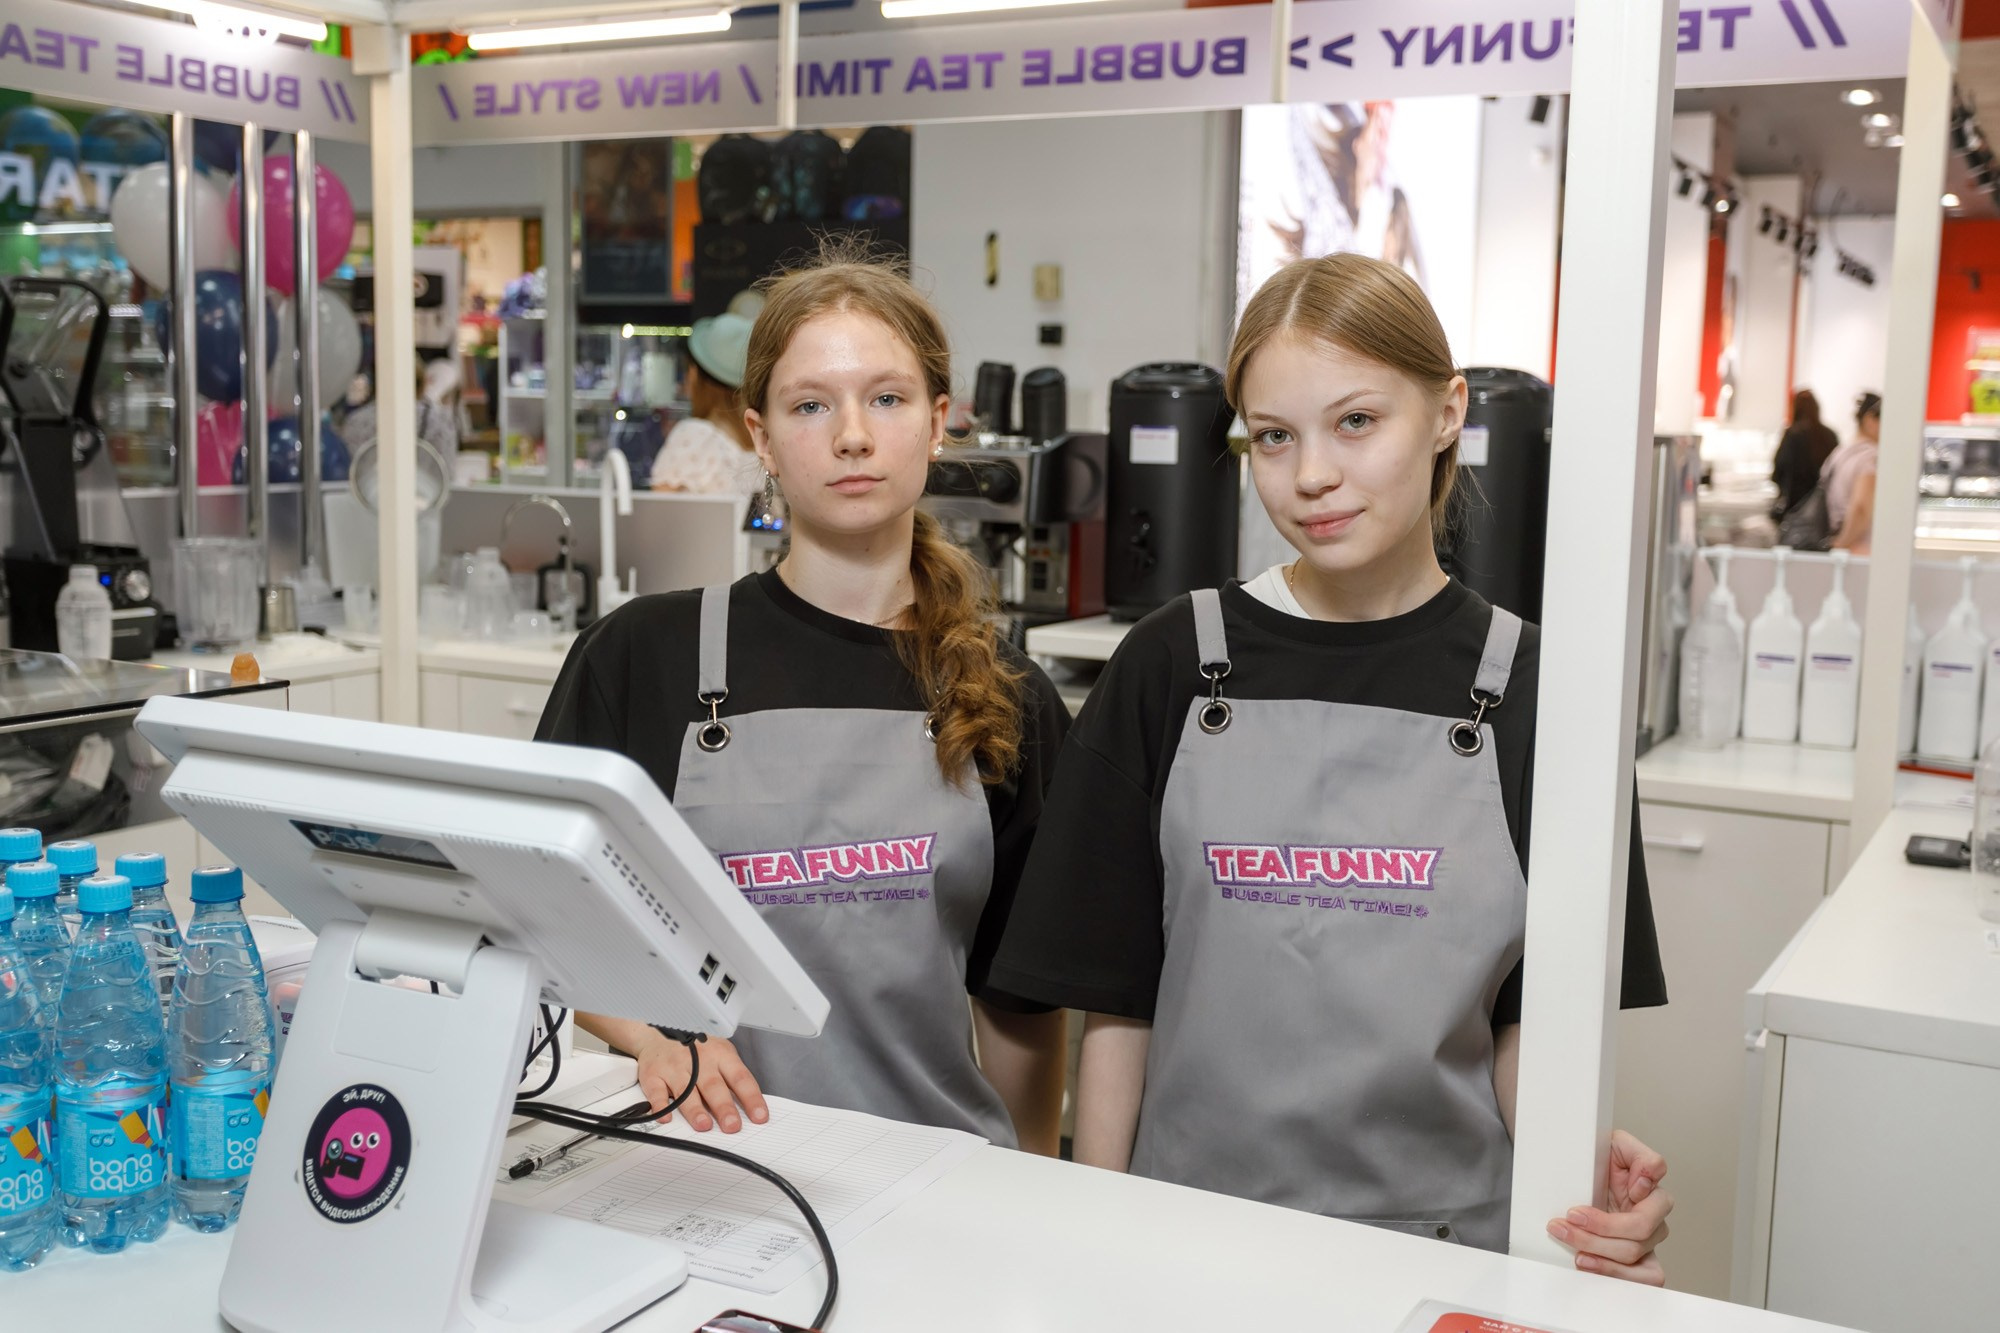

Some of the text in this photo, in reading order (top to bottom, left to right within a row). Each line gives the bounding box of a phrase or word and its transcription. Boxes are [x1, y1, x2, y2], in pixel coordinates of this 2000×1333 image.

[726, 838, 931, 887] TEA FUNNY
[1210, 848, 1435, 884] TEA FUNNY
[820, 891, 857, 904] TEA
[1222, 887, 1301, 906] BUBBLE
[1306, 895, 1346, 910] TEA
[0, 1169, 43, 1193] ona
[90, 1169, 152, 1192] aqua
[320, 1165, 405, 1220] ВИДЕОНАБЛЮДЕНИЕ
[0, 1184, 43, 1211] qua
